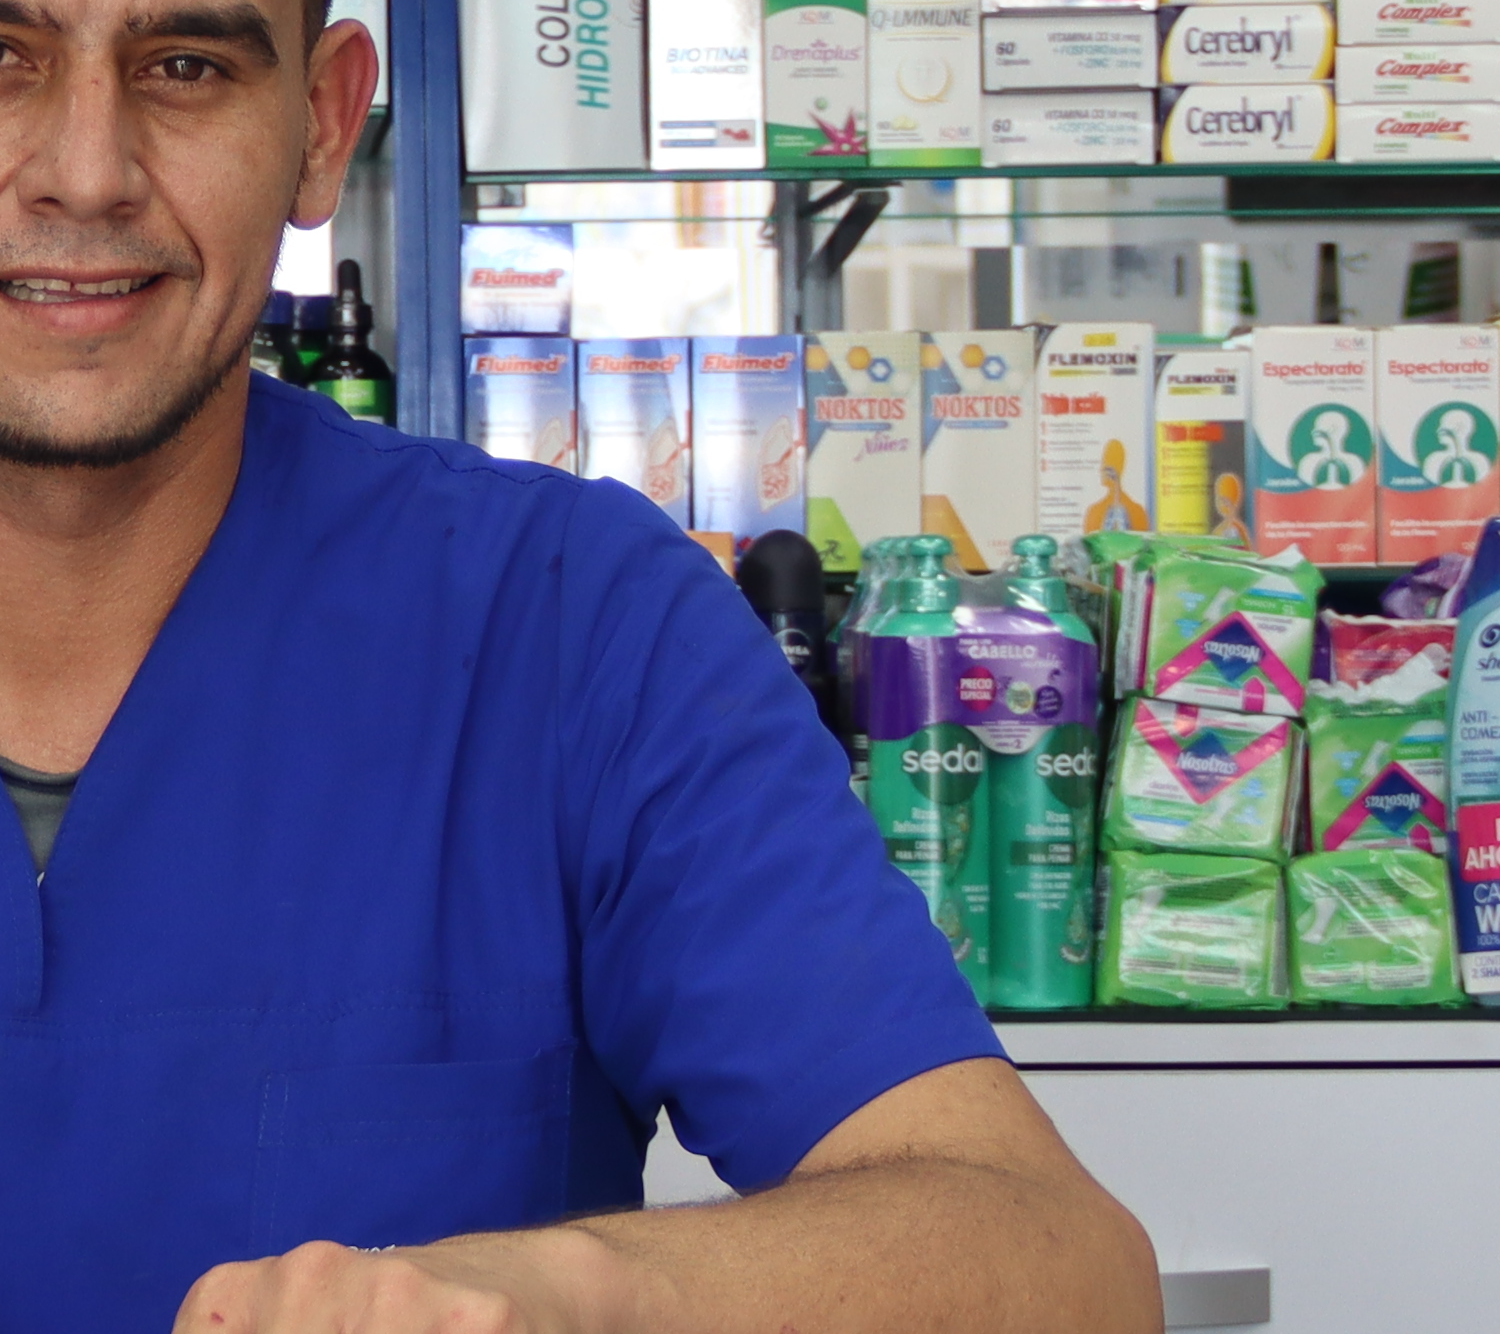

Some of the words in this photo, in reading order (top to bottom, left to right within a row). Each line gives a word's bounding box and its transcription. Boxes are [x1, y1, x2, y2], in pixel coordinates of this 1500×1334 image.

[470, 267, 561, 289] Fluimed
[1046, 349, 1139, 367] FLEMOXIN
[815, 396, 908, 422] NOKTOS
